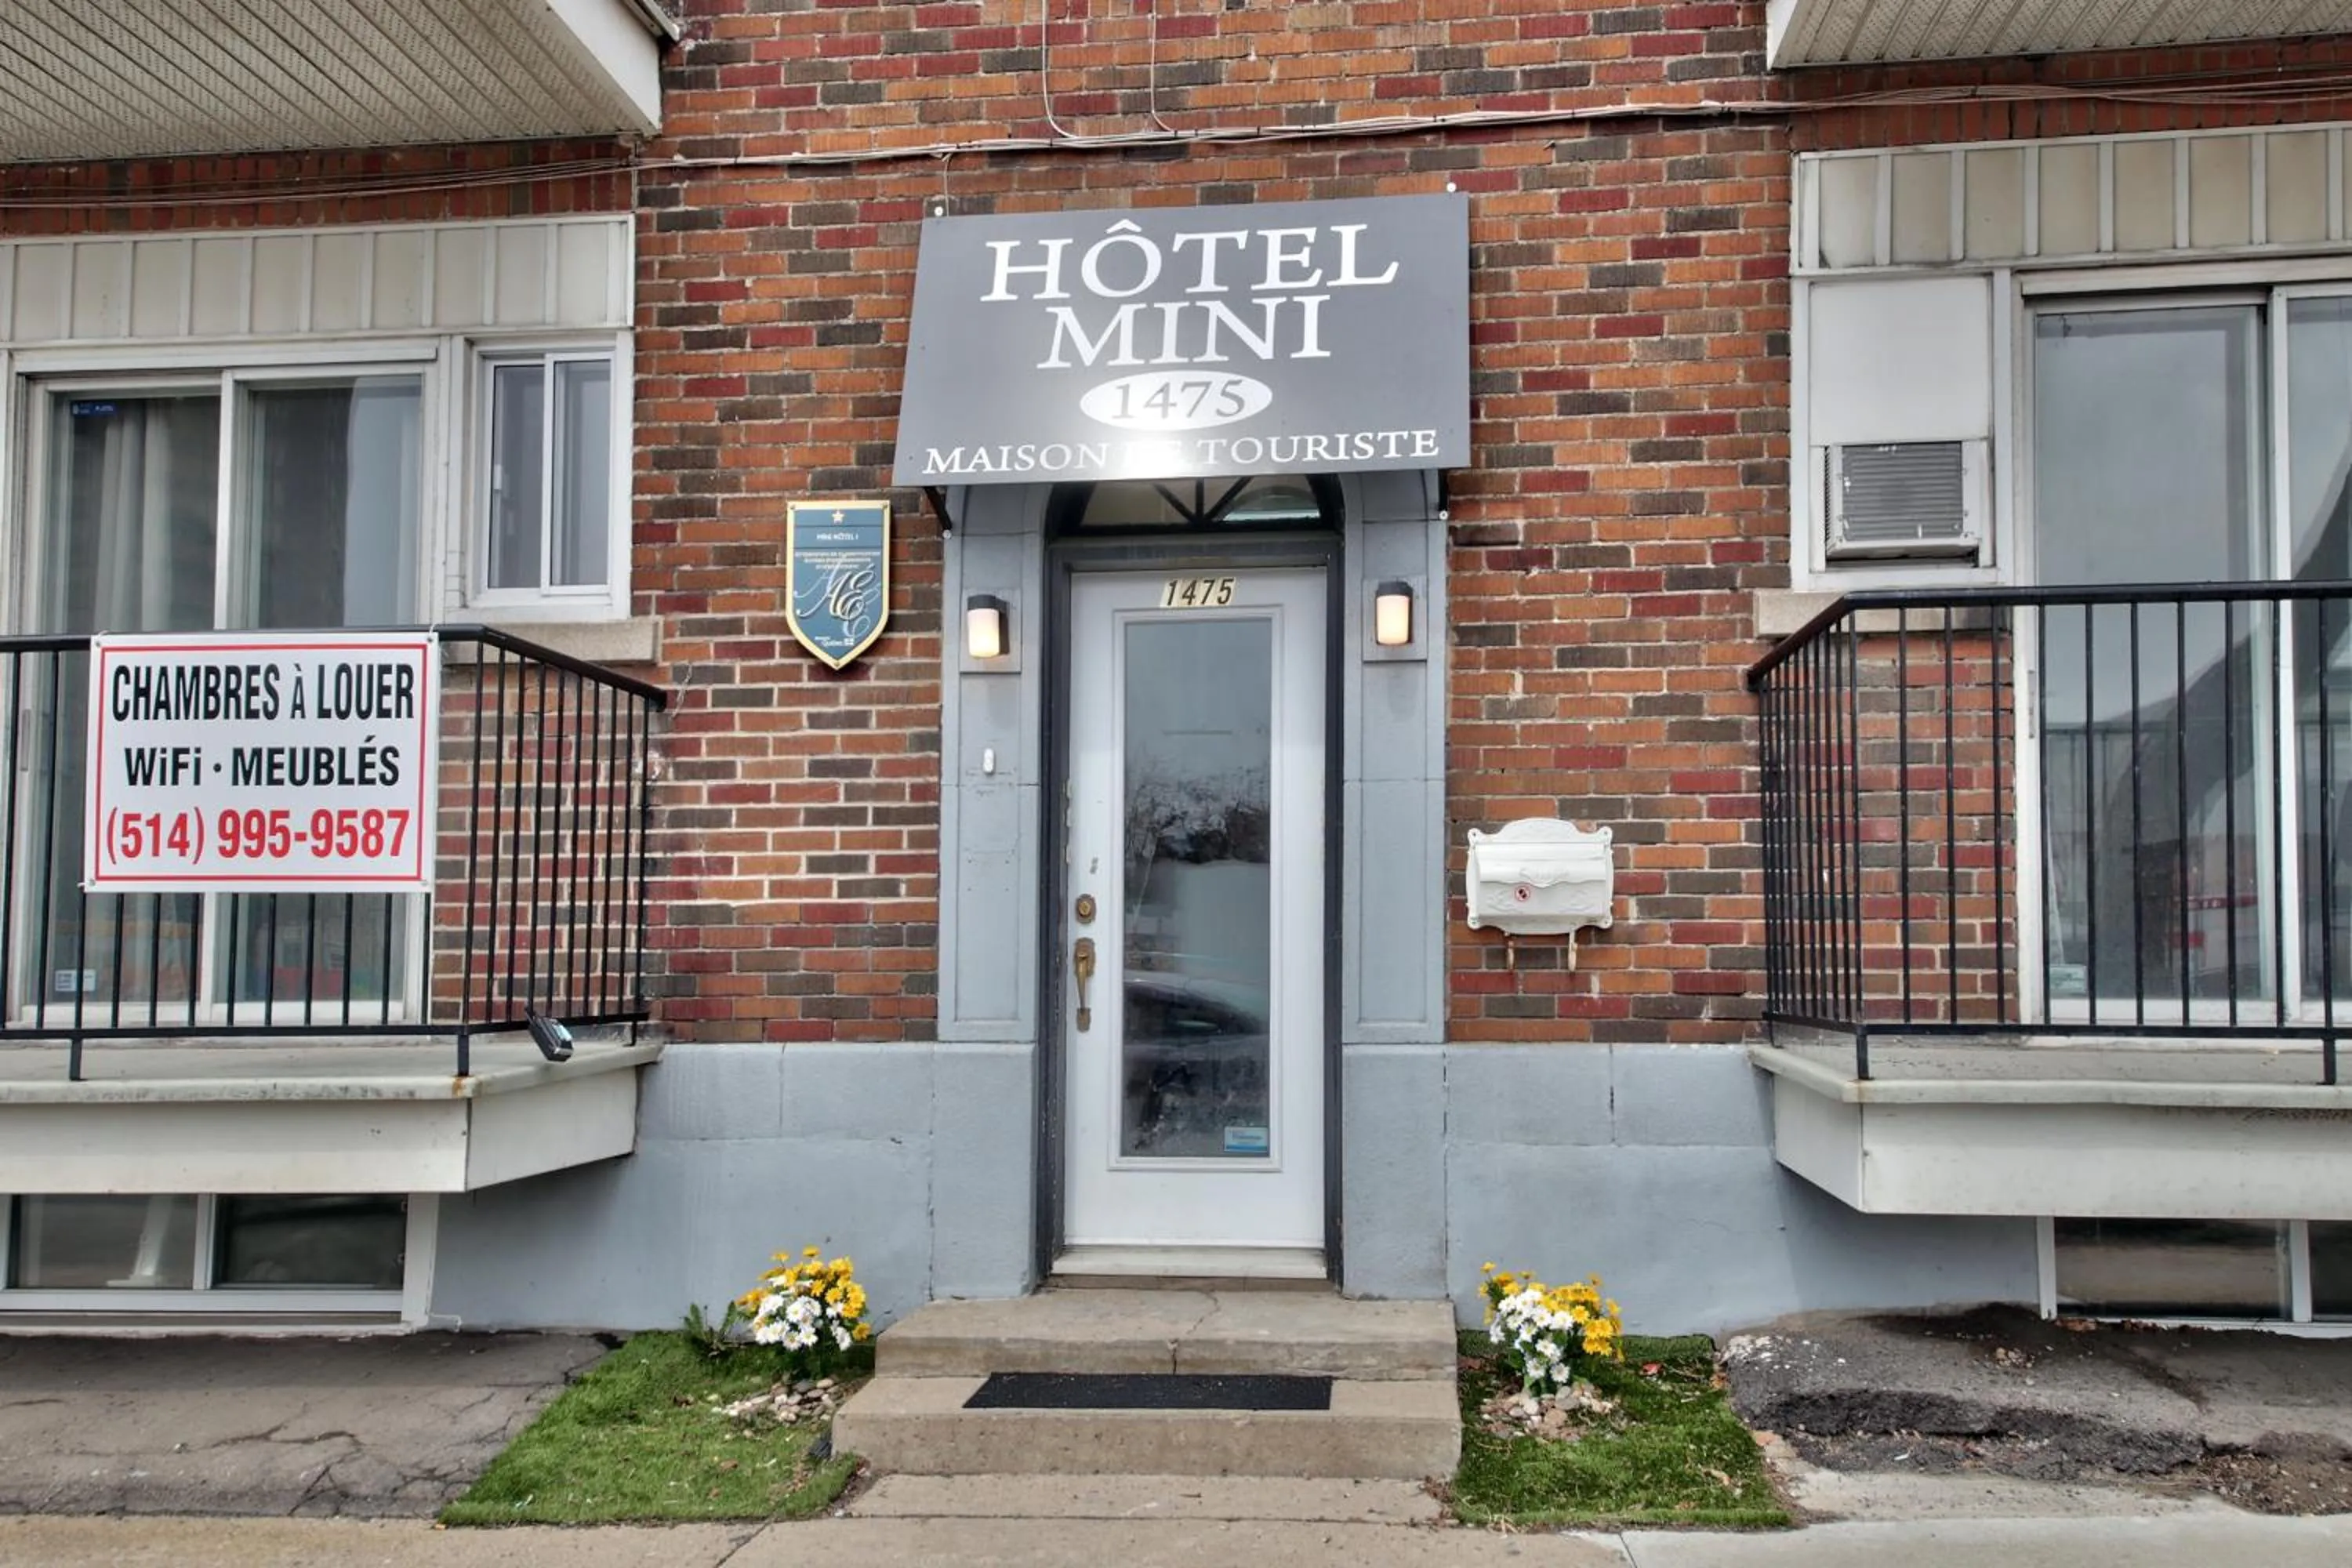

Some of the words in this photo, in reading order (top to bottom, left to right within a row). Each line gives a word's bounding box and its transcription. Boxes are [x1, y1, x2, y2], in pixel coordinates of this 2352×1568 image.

[980, 219, 1399, 302] HÔTEL
[1036, 294, 1331, 369] MINI
[1111, 379, 1247, 420] 1475
[921, 442, 1109, 474] MAISON
[1196, 429, 1439, 466] TOURISTE
[1166, 578, 1235, 606] 1475
[112, 663, 281, 722] CHAMBRES
[290, 663, 307, 720] À
[317, 662, 415, 720] LOUER
[125, 746, 202, 787] WiFi
[231, 735, 401, 787] MEUBLÉS
[107, 806, 205, 866] (514)
[217, 808, 410, 858] 995-9587
